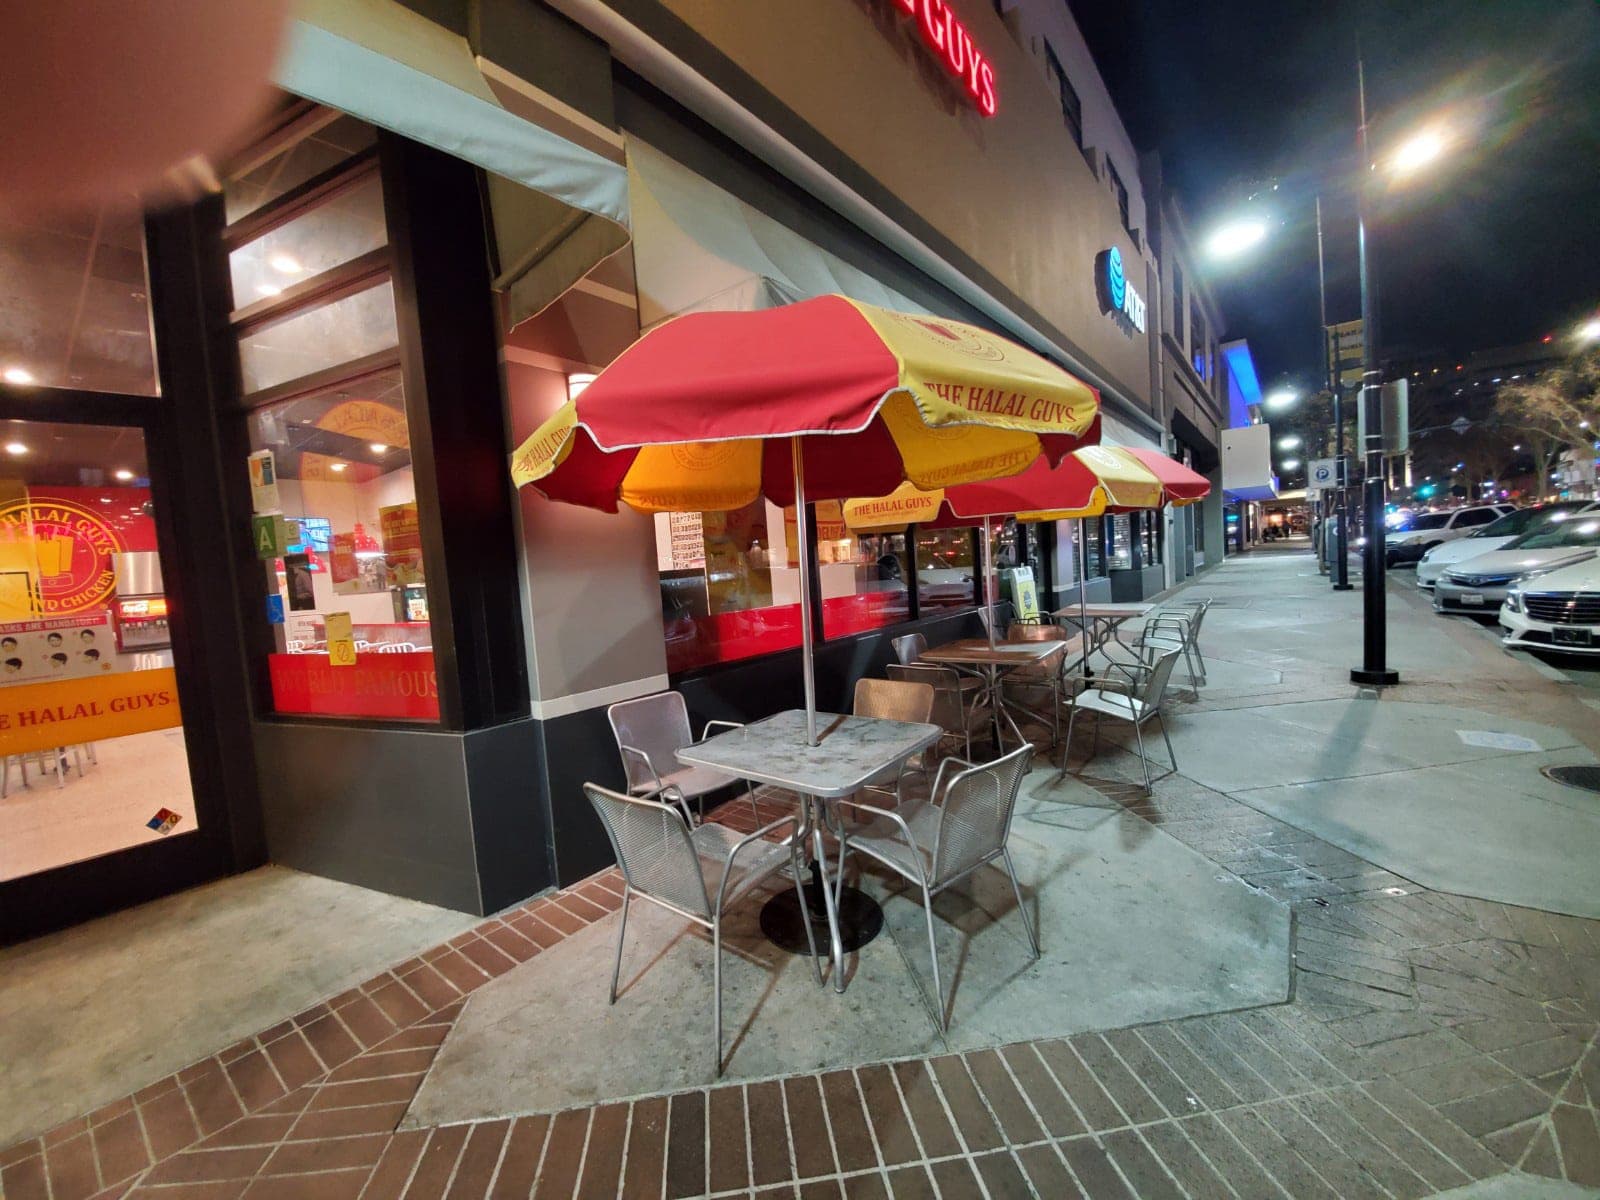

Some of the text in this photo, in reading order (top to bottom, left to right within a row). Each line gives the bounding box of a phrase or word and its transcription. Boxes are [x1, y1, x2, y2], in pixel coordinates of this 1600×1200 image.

[922, 0, 995, 115] GUYS
[1124, 280, 1145, 334] AT&T
[923, 383, 964, 407] THE
[966, 387, 1027, 417] HALAL
[1029, 399, 1078, 424] GUYS
[853, 504, 872, 516] THE
[872, 499, 904, 515] HALAL
[906, 496, 933, 509] GUYS
[75, 519, 114, 556] GUYS
[259, 525, 274, 551] A
[61, 569, 115, 609] CHICKEN
[18, 701, 104, 727] HALAL
[110, 691, 170, 713] GUYS
